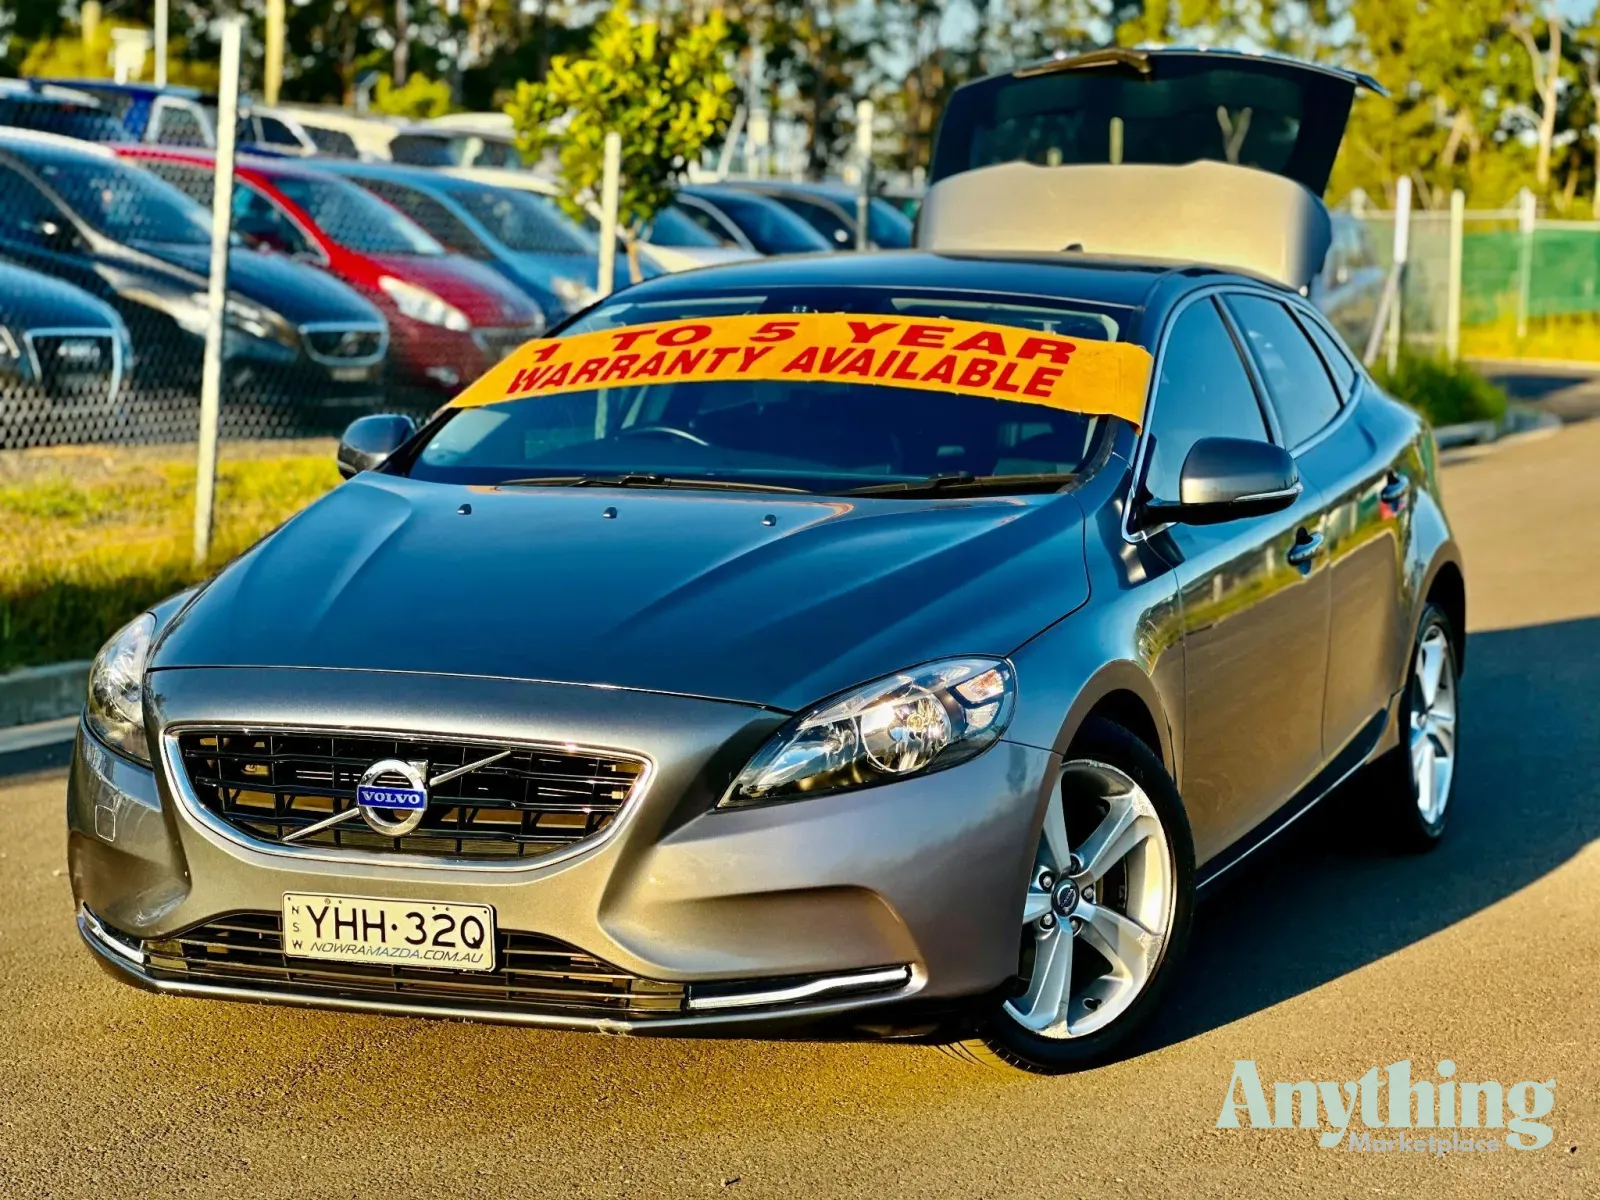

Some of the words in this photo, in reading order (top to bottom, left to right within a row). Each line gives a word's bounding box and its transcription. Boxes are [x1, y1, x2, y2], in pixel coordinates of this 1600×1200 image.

[533, 343, 562, 363] 1
[611, 324, 713, 352] TO
[748, 321, 800, 343] 5
[847, 321, 1077, 365] YEAR
[506, 346, 776, 394] WARRANTY
[781, 346, 1065, 398] AVAILABLE
[361, 790, 420, 805] VOLVO
[310, 942, 484, 963] NOWRAMAZDA.COM.AU
